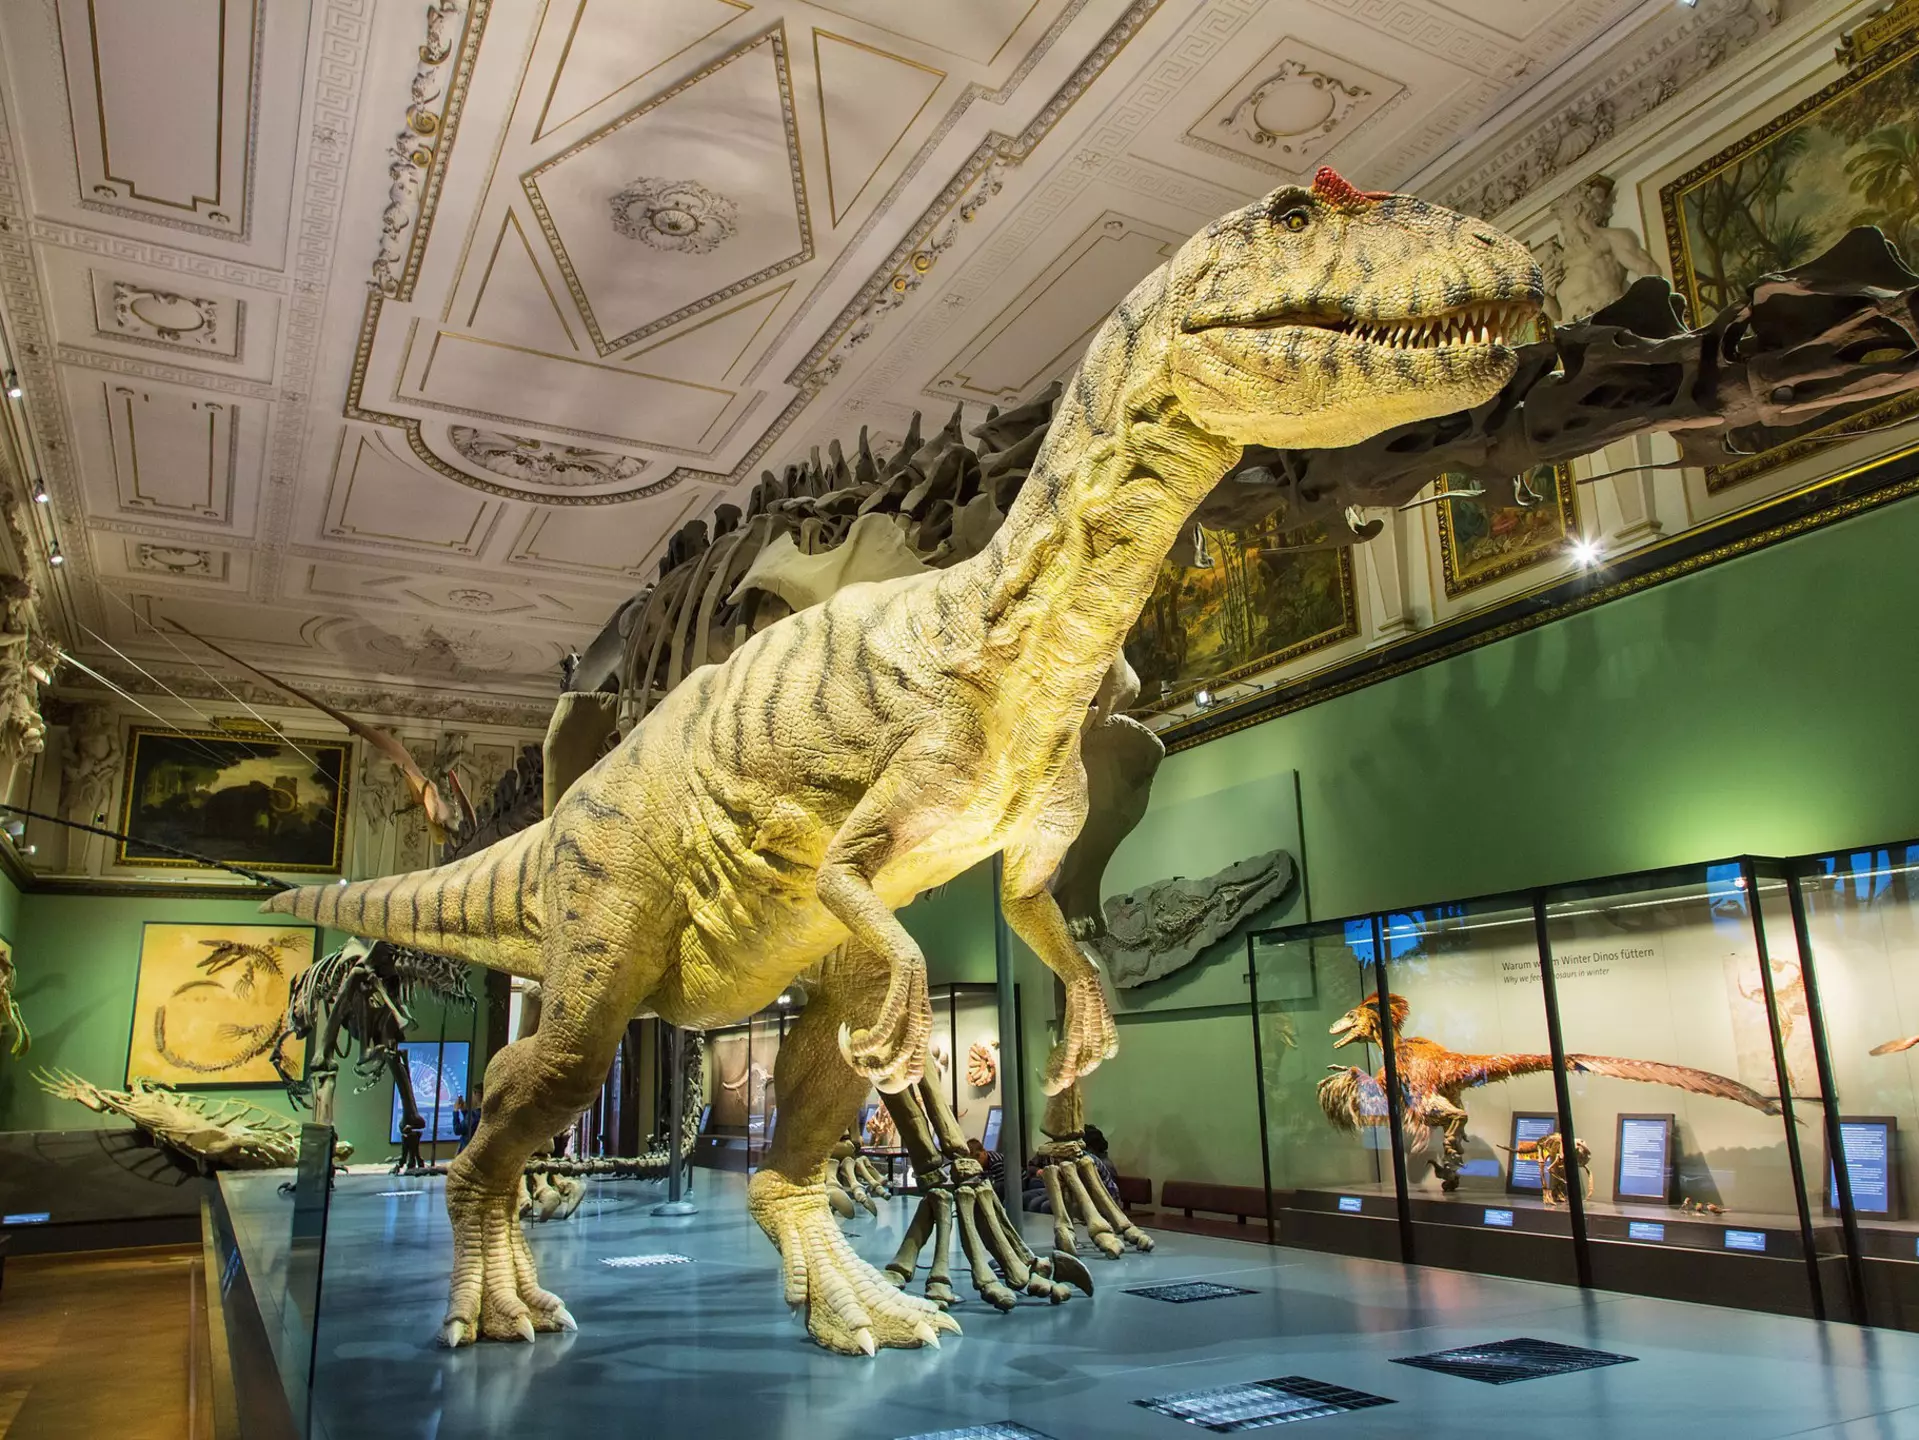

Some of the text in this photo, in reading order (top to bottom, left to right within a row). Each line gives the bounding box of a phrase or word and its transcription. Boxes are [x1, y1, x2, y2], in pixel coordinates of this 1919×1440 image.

[1501, 961, 1532, 971] Warum
[1560, 954, 1592, 965] Winter
[1592, 951, 1619, 963] Dinos
[1620, 948, 1655, 960] füttern
[1503, 975, 1519, 985] Why
[1578, 969, 1586, 977] in
[1586, 968, 1610, 977] winter
